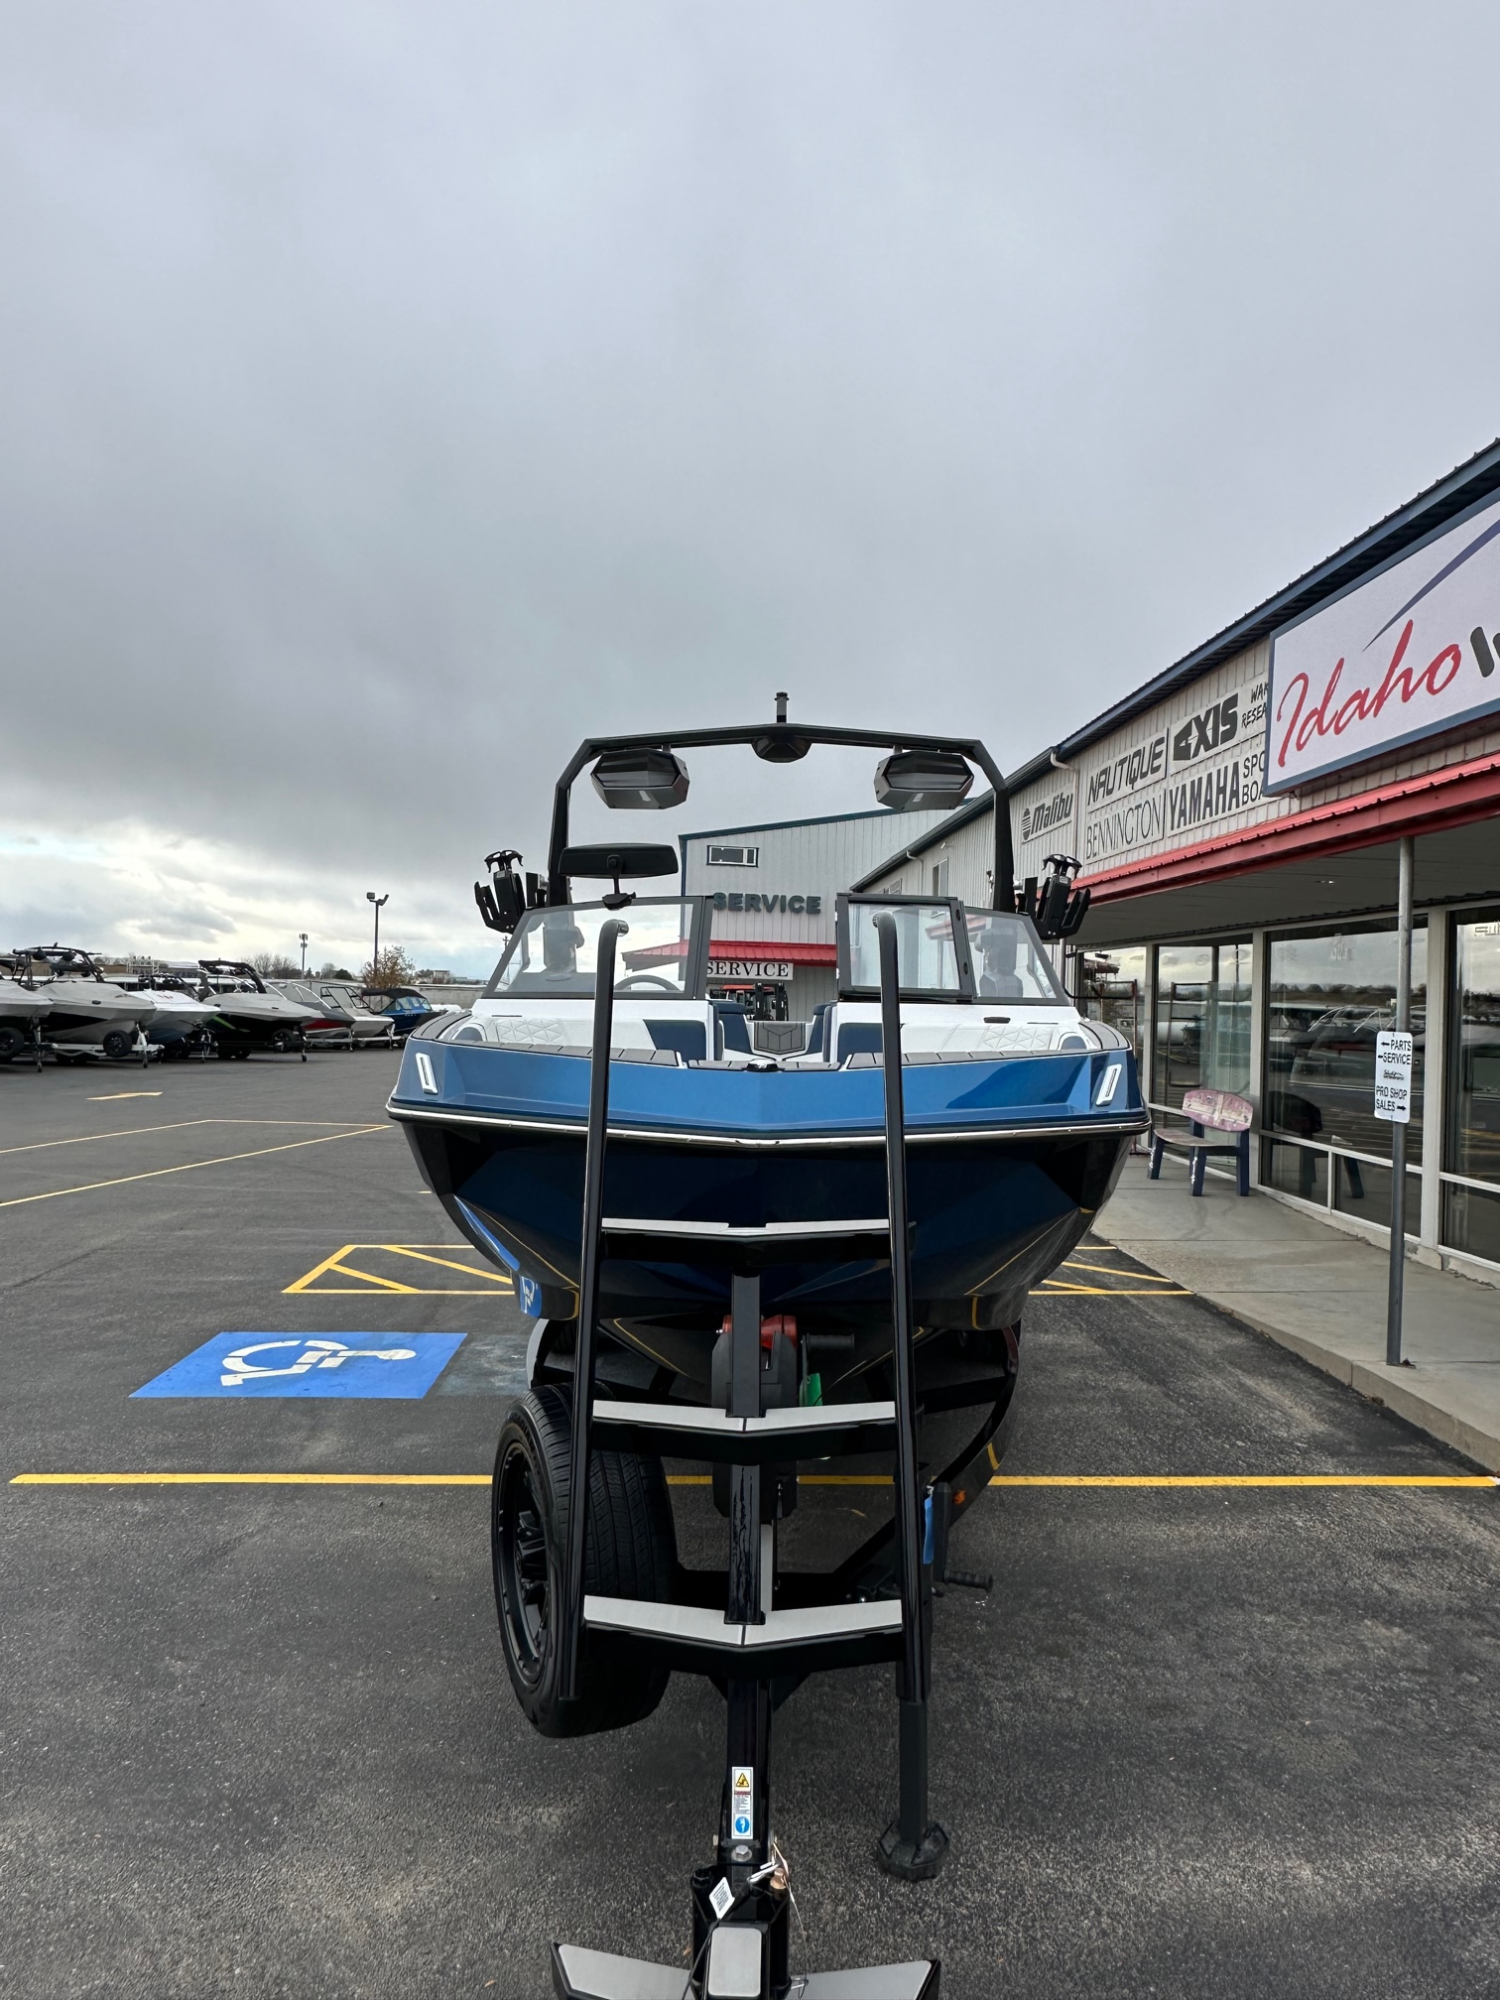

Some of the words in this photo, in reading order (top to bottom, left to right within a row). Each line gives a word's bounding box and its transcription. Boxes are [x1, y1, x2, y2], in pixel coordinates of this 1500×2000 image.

[1277, 619, 1461, 767] Idaho
[1087, 736, 1165, 806] NAUTIQUE
[1169, 760, 1240, 831] YAMAHA
[1086, 794, 1162, 860] BENNINGTON
[713, 892, 821, 915] SERVICE
[707, 961, 789, 978] SERVICE
[1391, 1040, 1412, 1052] PARTS
[1383, 1052, 1411, 1065] SERVICE
[1376, 1085, 1389, 1098] PRO
[1390, 1087, 1408, 1100] SHOP
[1376, 1099, 1396, 1112] SALES
